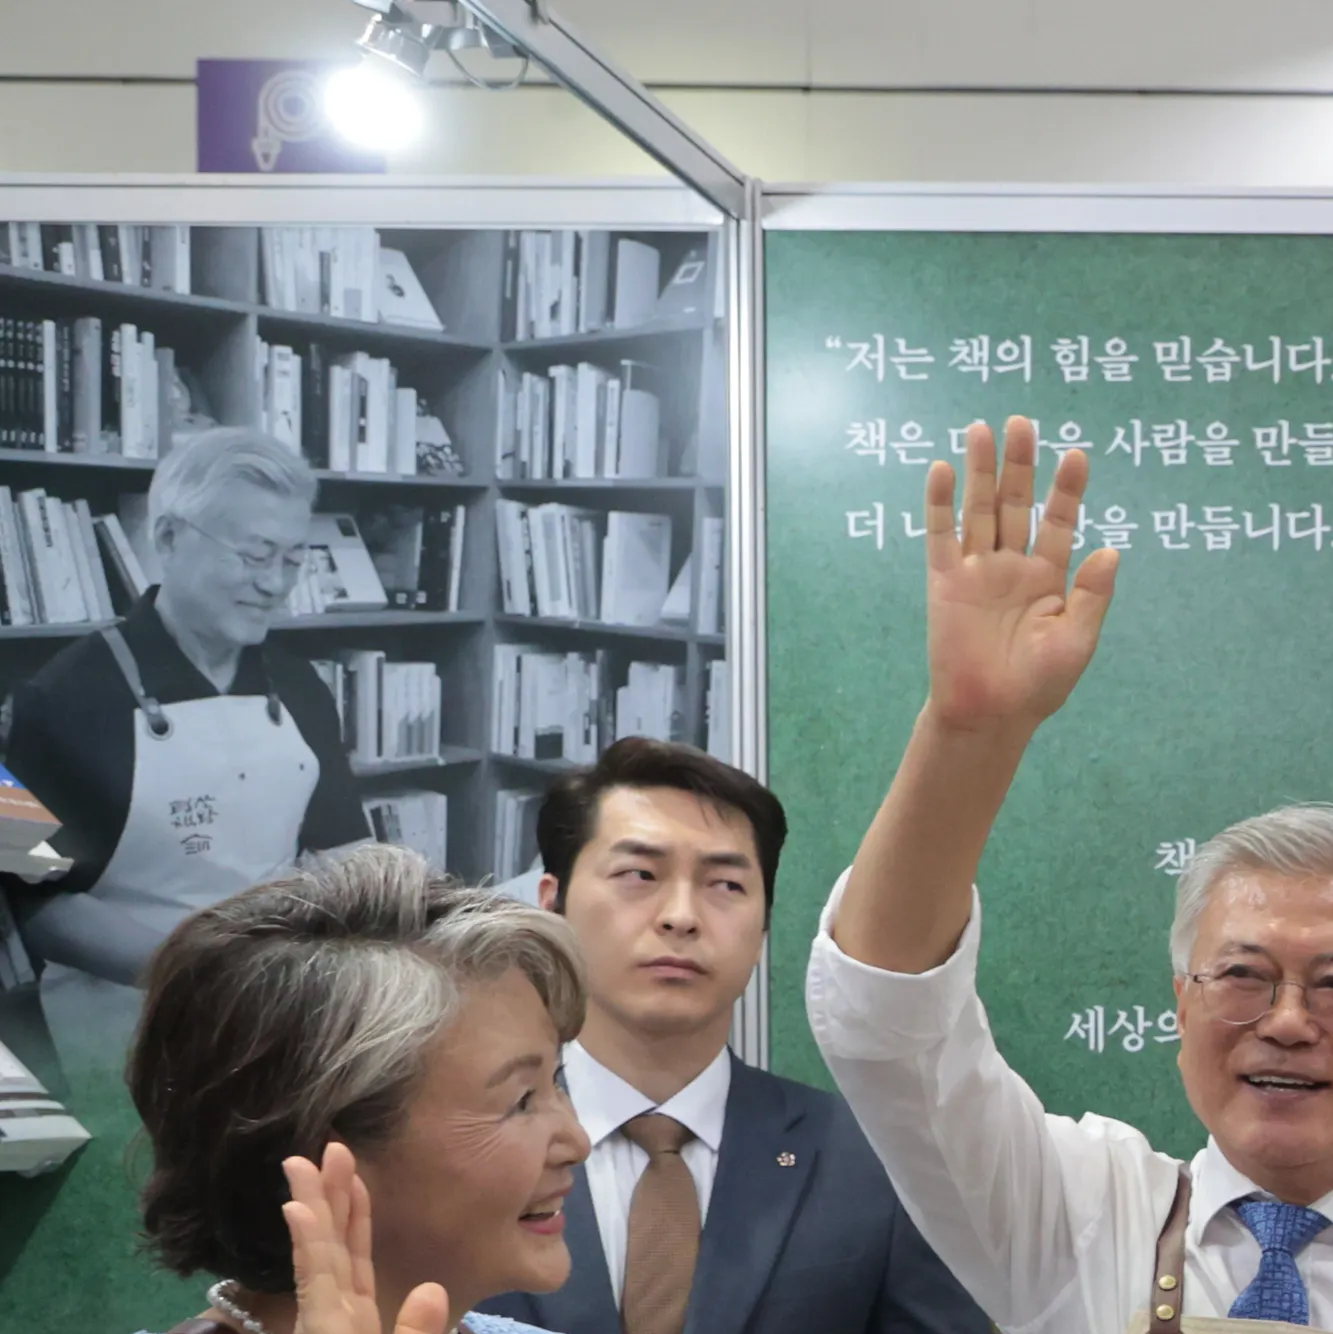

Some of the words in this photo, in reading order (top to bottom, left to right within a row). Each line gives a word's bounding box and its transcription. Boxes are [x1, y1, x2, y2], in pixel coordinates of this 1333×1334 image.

[825, 333, 935, 383] “저는
[948, 335, 1034, 385] 책의
[1050, 335, 1140, 384] 힘을
[844, 419, 935, 468] 책은
[1105, 419, 1241, 468] 사람을
[845, 502, 887, 550] 더
